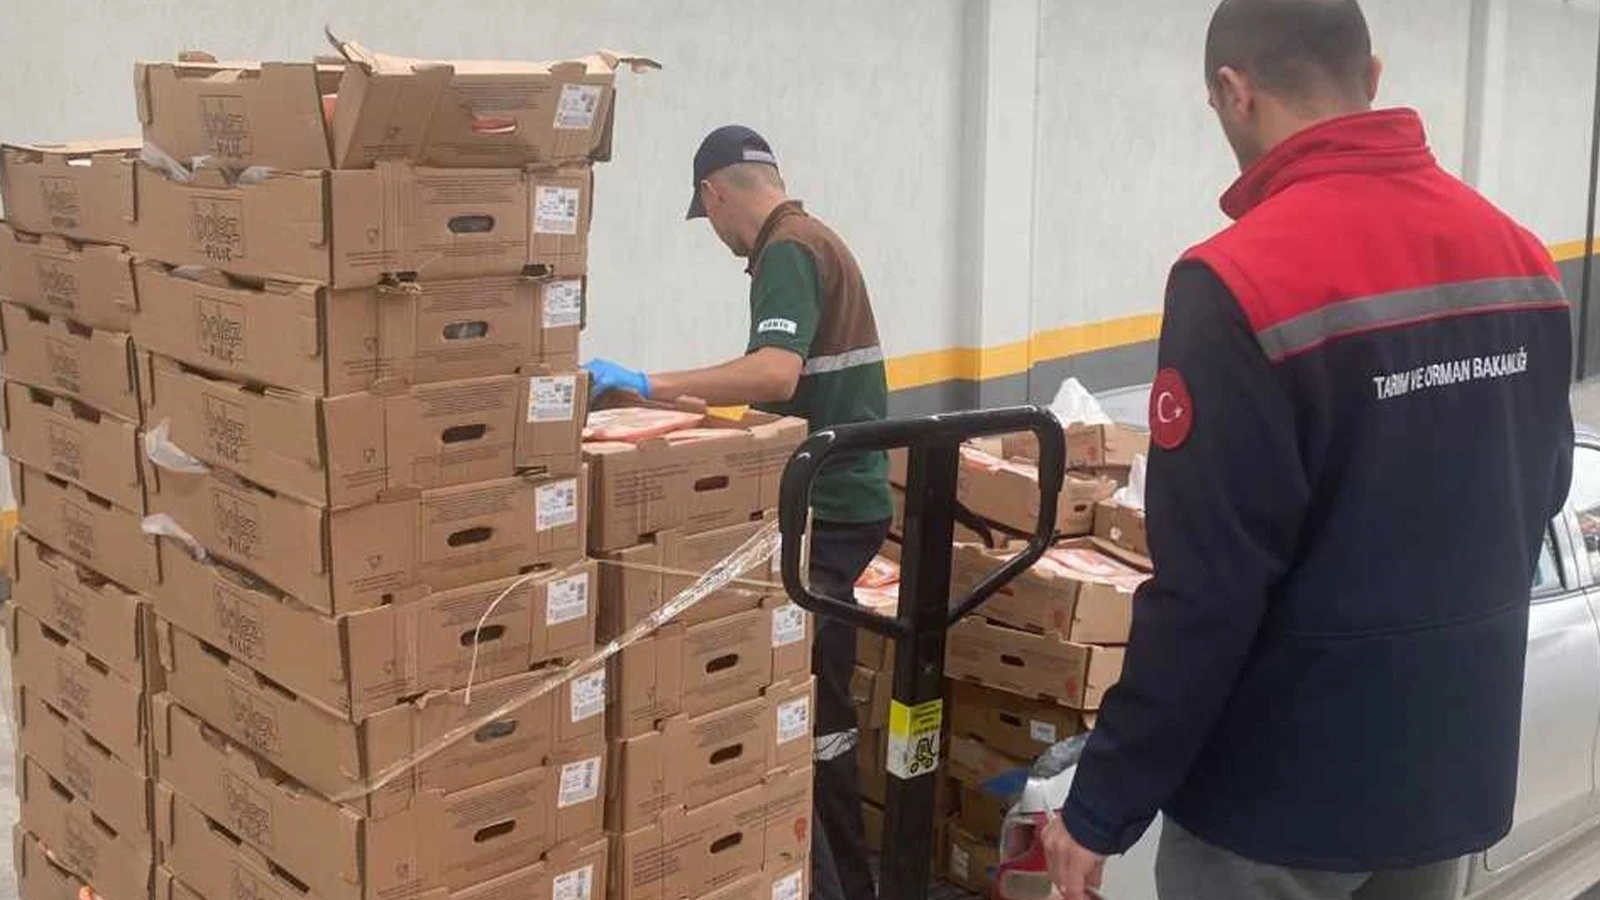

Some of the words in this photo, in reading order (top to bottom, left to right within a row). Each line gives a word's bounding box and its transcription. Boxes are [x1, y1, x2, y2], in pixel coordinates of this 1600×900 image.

[1372, 371, 1410, 399] TARIM
[1410, 367, 1424, 391] VE
[1424, 360, 1470, 388] ORMAN
